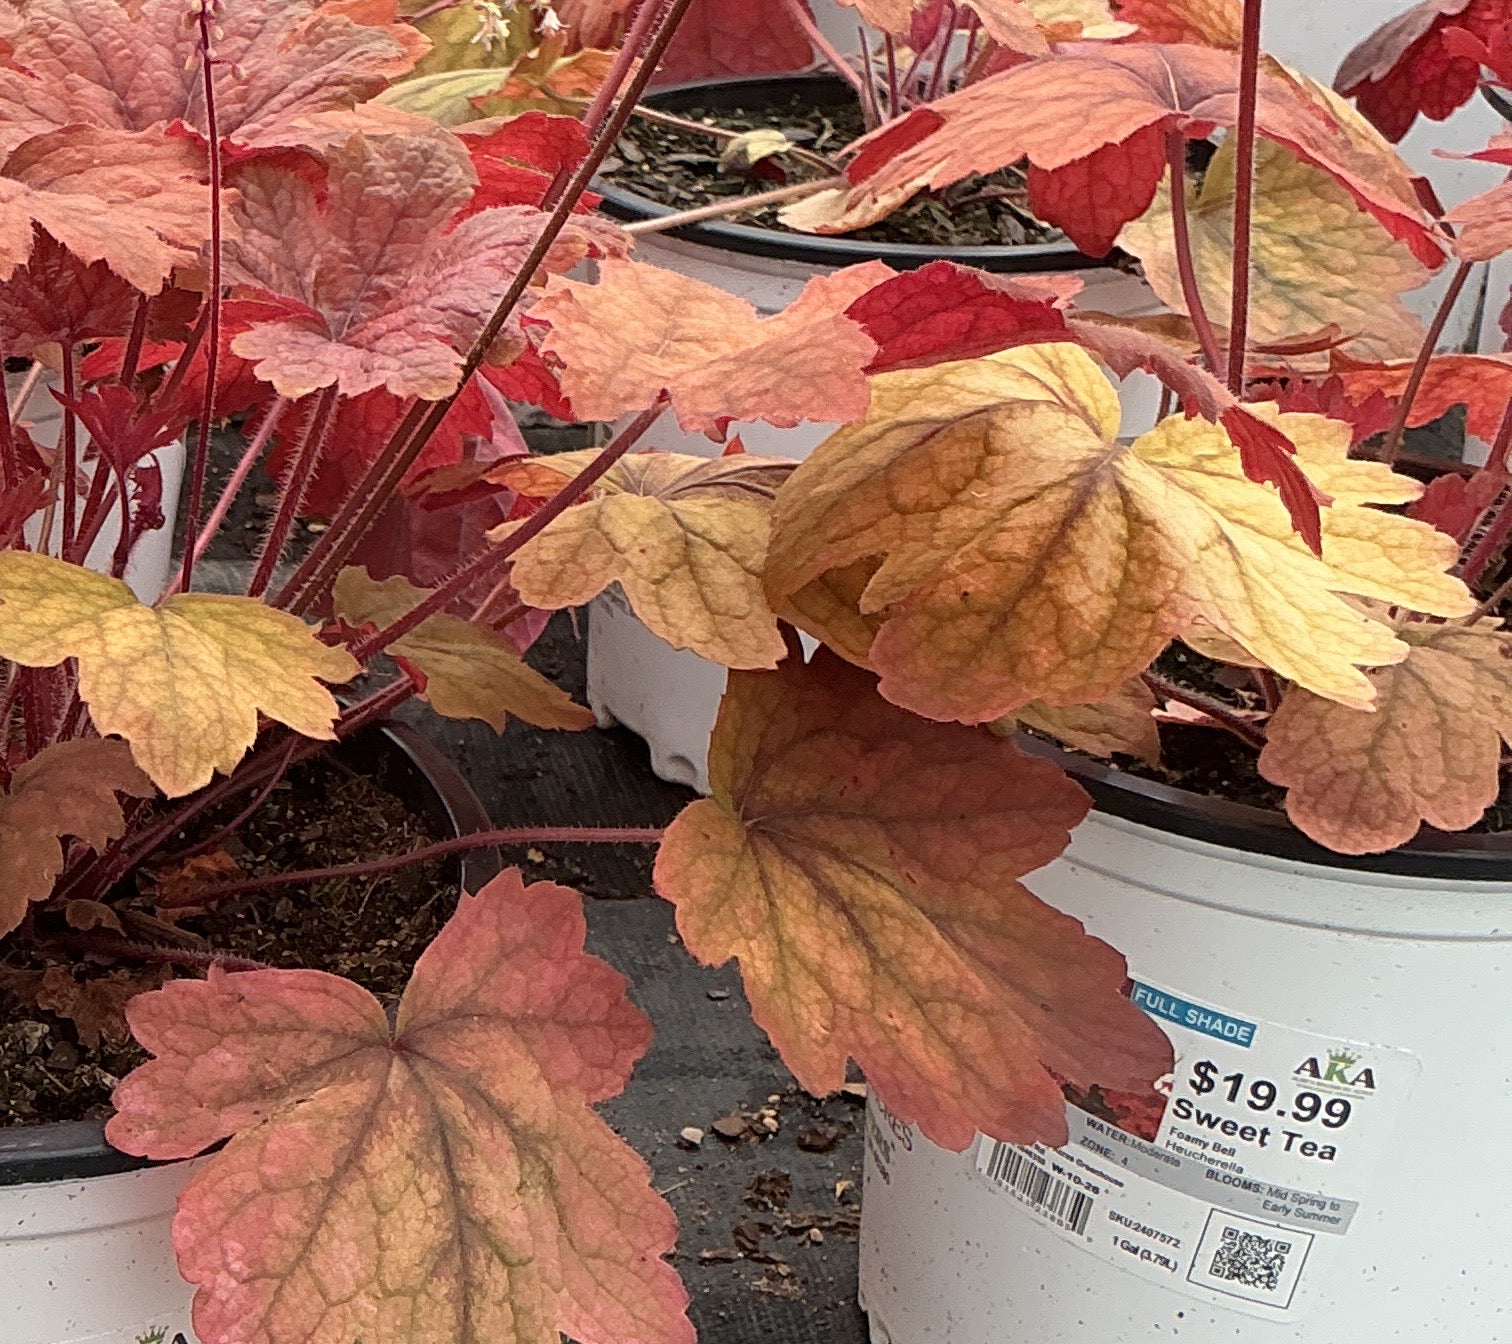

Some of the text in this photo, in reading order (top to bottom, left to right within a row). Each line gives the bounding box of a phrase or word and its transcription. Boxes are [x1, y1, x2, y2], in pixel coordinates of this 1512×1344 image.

[1134, 988, 1252, 1043] FULL SHADE
[1293, 1057, 1376, 1089] AKA
[1188, 1060, 1352, 1129] $19.99
[1168, 1125, 1236, 1157] Foamy Bell
[1172, 1097, 1337, 1161] Sweet Tea
[1079, 1136, 1129, 1167] ZONE: 4
[1165, 1139, 1244, 1174] Heucherella
[1205, 1168, 1341, 1212] BLOOMS: Mid Spring to
[1262, 1199, 1342, 1225] Early Summer
[1112, 1235, 1119, 1247] 1
[1120, 1239, 1138, 1256] Gal
